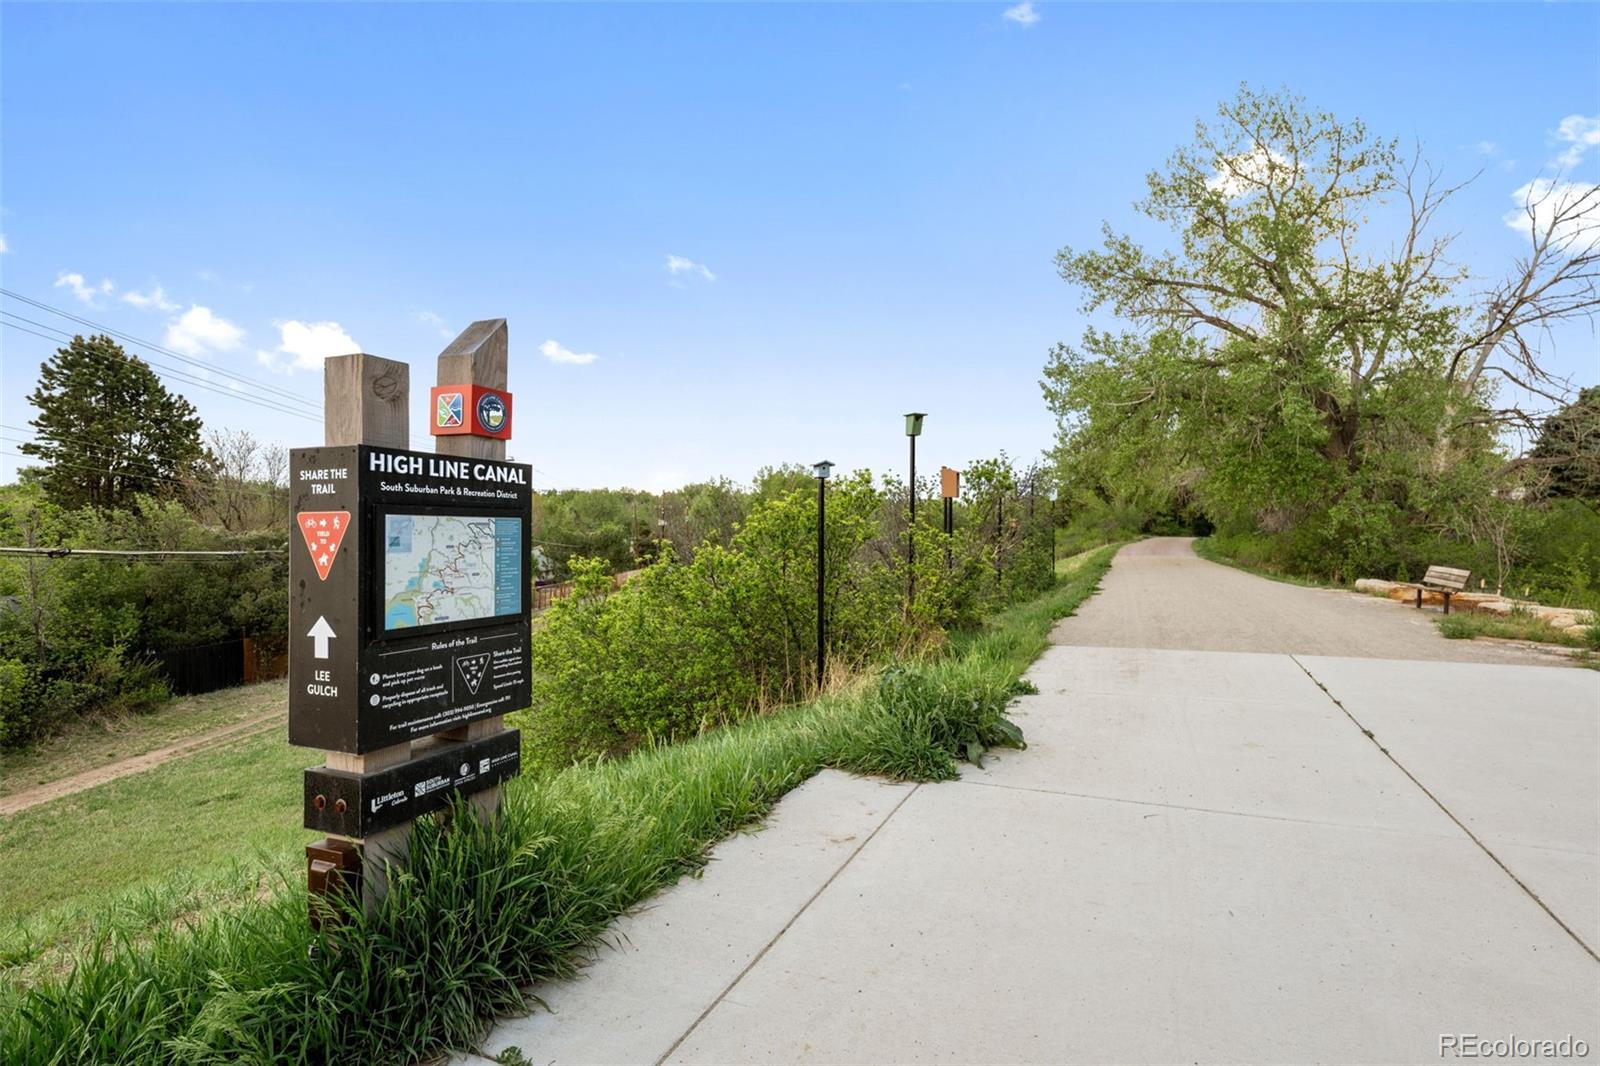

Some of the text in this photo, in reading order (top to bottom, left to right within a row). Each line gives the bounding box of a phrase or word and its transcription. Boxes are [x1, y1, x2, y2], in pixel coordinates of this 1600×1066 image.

[300, 468, 348, 480] SHARE THE
[369, 452, 527, 485] HIGH LINE CANAL
[311, 484, 336, 494] TRAIL
[380, 481, 518, 500] South Suburban Park & Recreation District
[431, 642, 448, 650] Rules
[466, 636, 478, 644] Trail
[314, 669, 331, 681] LEE
[307, 683, 338, 697] GULCH
[376, 790, 405, 805] Littleton
